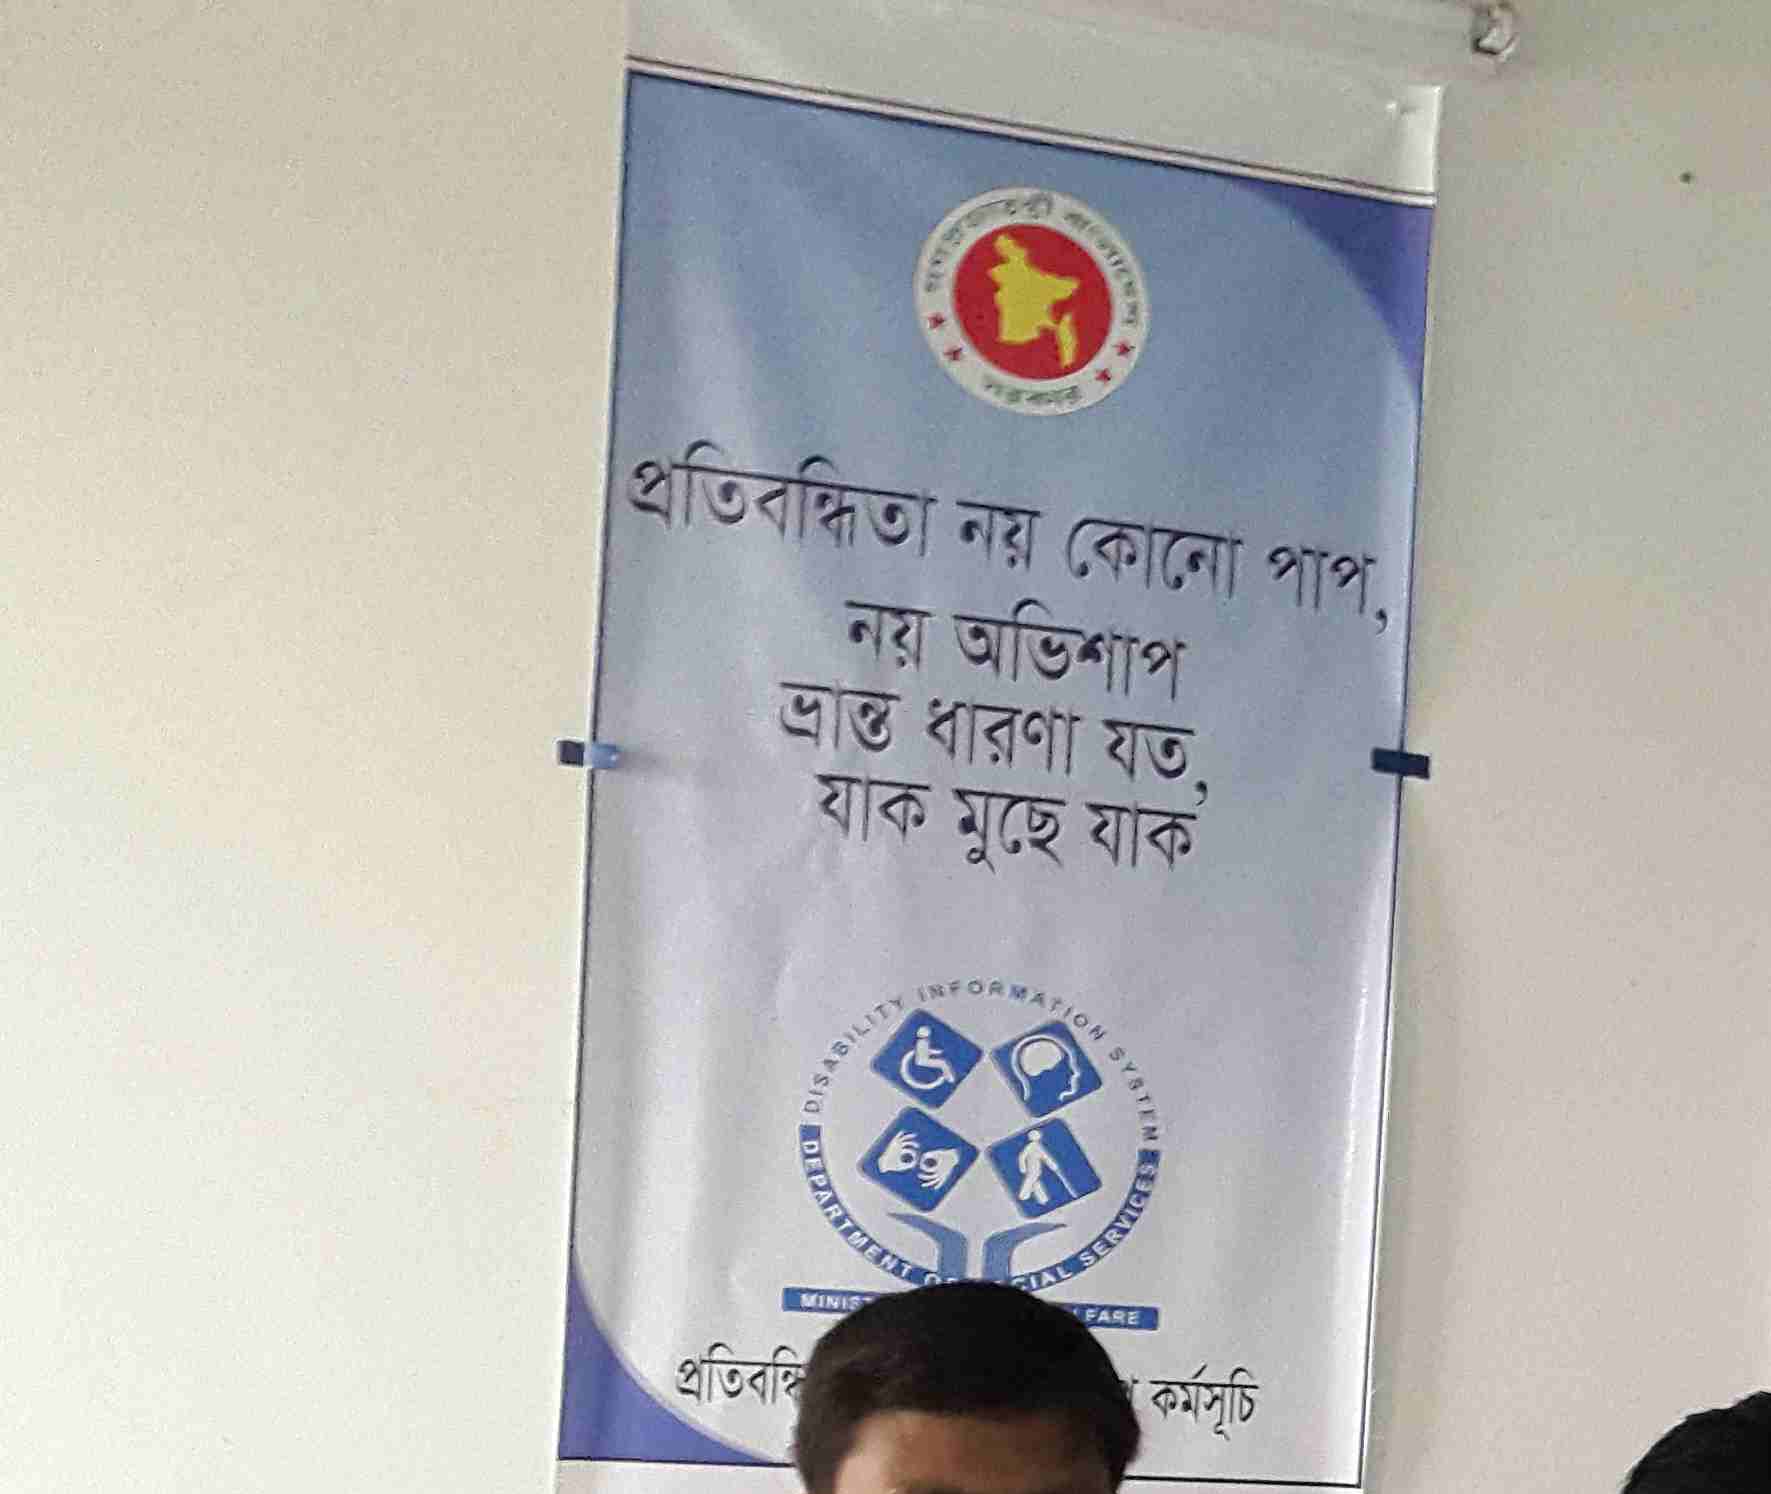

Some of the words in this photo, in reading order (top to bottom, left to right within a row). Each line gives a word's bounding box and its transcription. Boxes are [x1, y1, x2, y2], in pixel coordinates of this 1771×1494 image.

[627, 439, 938, 557] প্রতিবন্ধিতা
[955, 501, 1041, 572] নয়
[1067, 518, 1242, 599] কোনো
[1267, 545, 1388, 636] পাপ,
[845, 600, 934, 671] নয়
[952, 598, 1187, 701] অভিশাপ
[779, 681, 901, 752] ভ্রান্ত
[925, 698, 1081, 776] ধারণা
[1102, 719, 1208, 805] যত,
[815, 774, 931, 842] যাক
[952, 788, 1067, 873] মুছে
[1085, 803, 1198, 872] যাক
[804, 996, 905, 1114] DISABILITY
[918, 980, 1105, 1041] INFORMATION
[1109, 1047, 1160, 1142] SYSTEM
[803, 1139, 913, 1278] DEPARTMENT
[1011, 1265, 1072, 1291] CIAL
[1079, 1164, 1157, 1266] SERVICES
[800, 1293, 874, 1310] MINIS
[1073, 1308, 1140, 1325] FARE
[676, 1342, 807, 1404] প্রতিবন্ধি
[1150, 1364, 1258, 1441] কর্মসূচি
